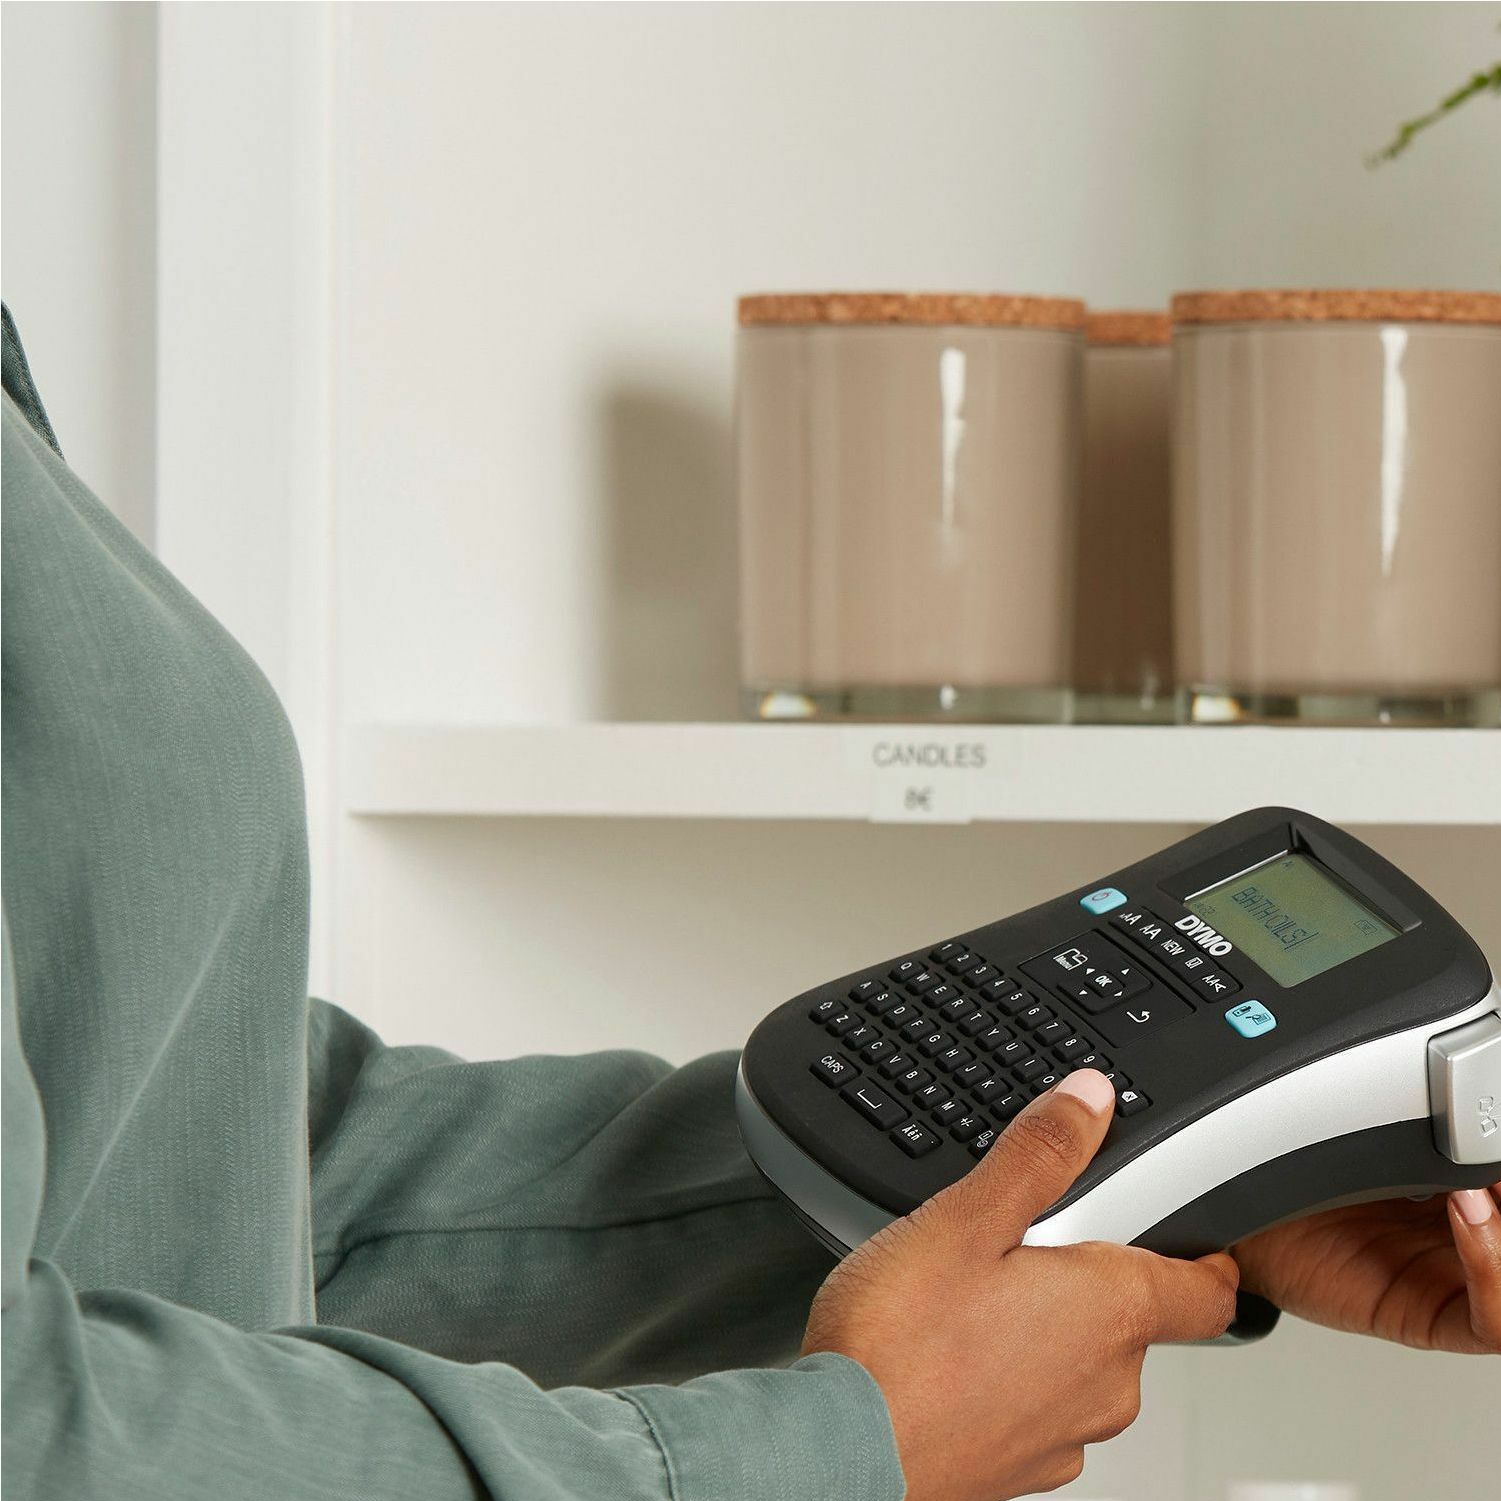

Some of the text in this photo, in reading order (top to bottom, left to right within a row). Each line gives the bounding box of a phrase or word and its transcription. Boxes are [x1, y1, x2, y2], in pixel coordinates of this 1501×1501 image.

[872, 742, 988, 769] CANDLES
[1174, 914, 1233, 957] DYMO
[1160, 939, 1186, 956] NEW
[1094, 975, 1113, 988] OK
[821, 1055, 844, 1073] CAPS
